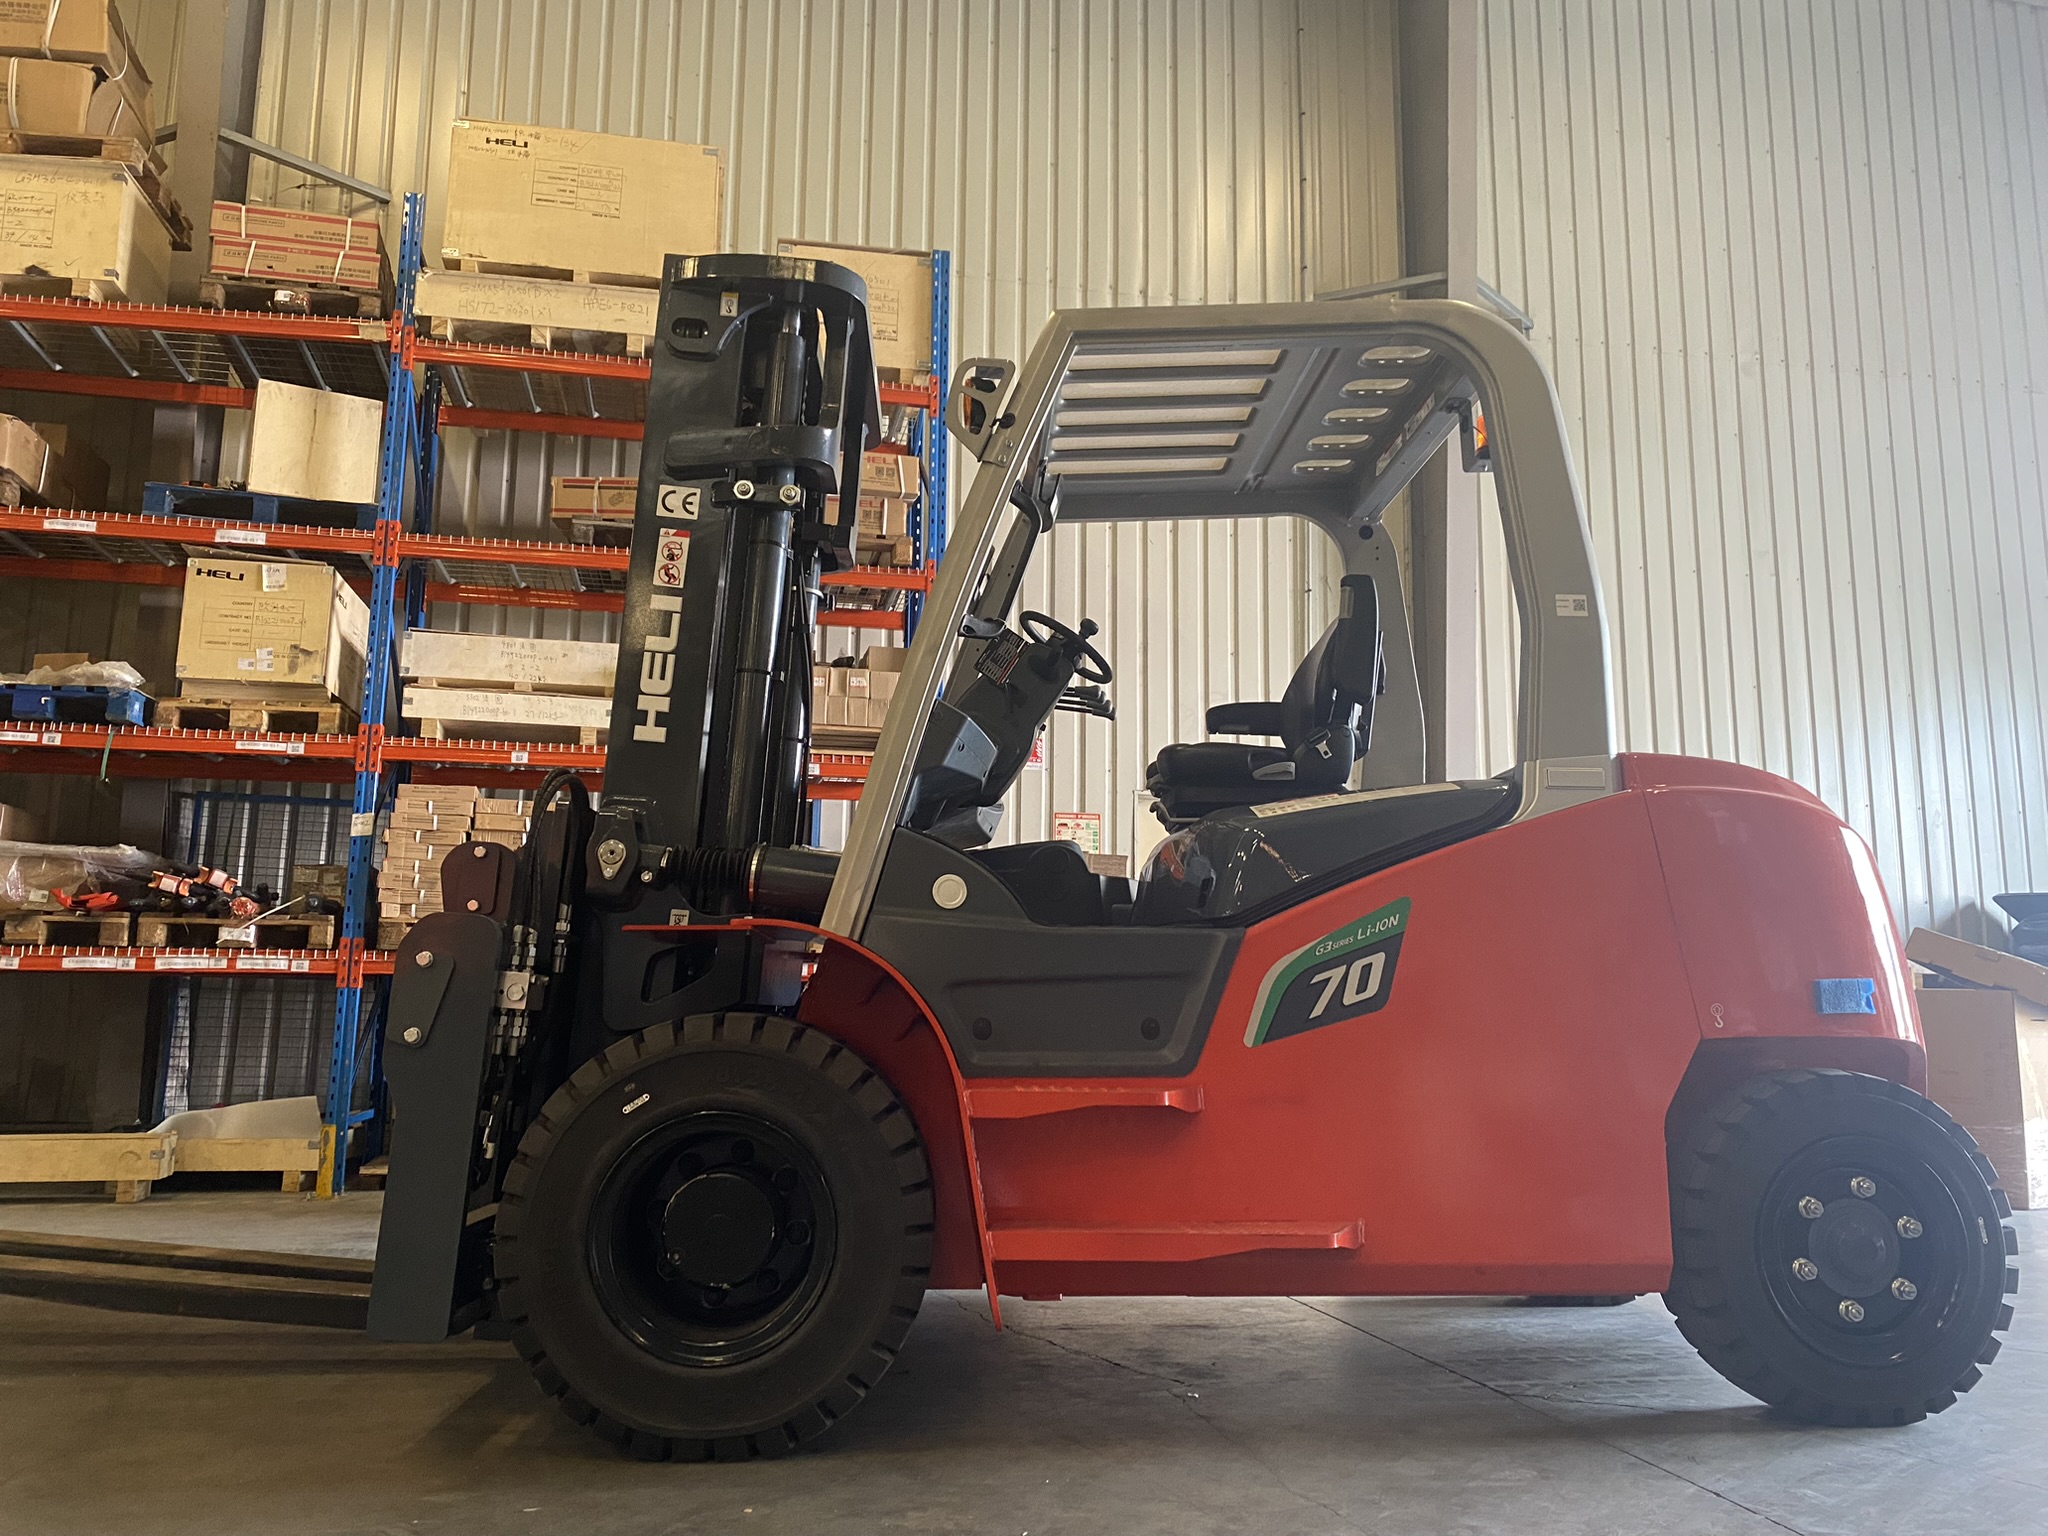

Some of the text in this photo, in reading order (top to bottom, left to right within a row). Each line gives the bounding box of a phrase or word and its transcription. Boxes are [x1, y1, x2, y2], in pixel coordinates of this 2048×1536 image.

[486, 136, 528, 149] HELI
[661, 489, 698, 516] CE
[196, 567, 245, 582] HELI
[336, 590, 348, 610] HELI
[632, 594, 684, 743] HELI
[1316, 914, 1400, 956] G3 SERIES Li-ION
[1308, 951, 1386, 1020] 70
